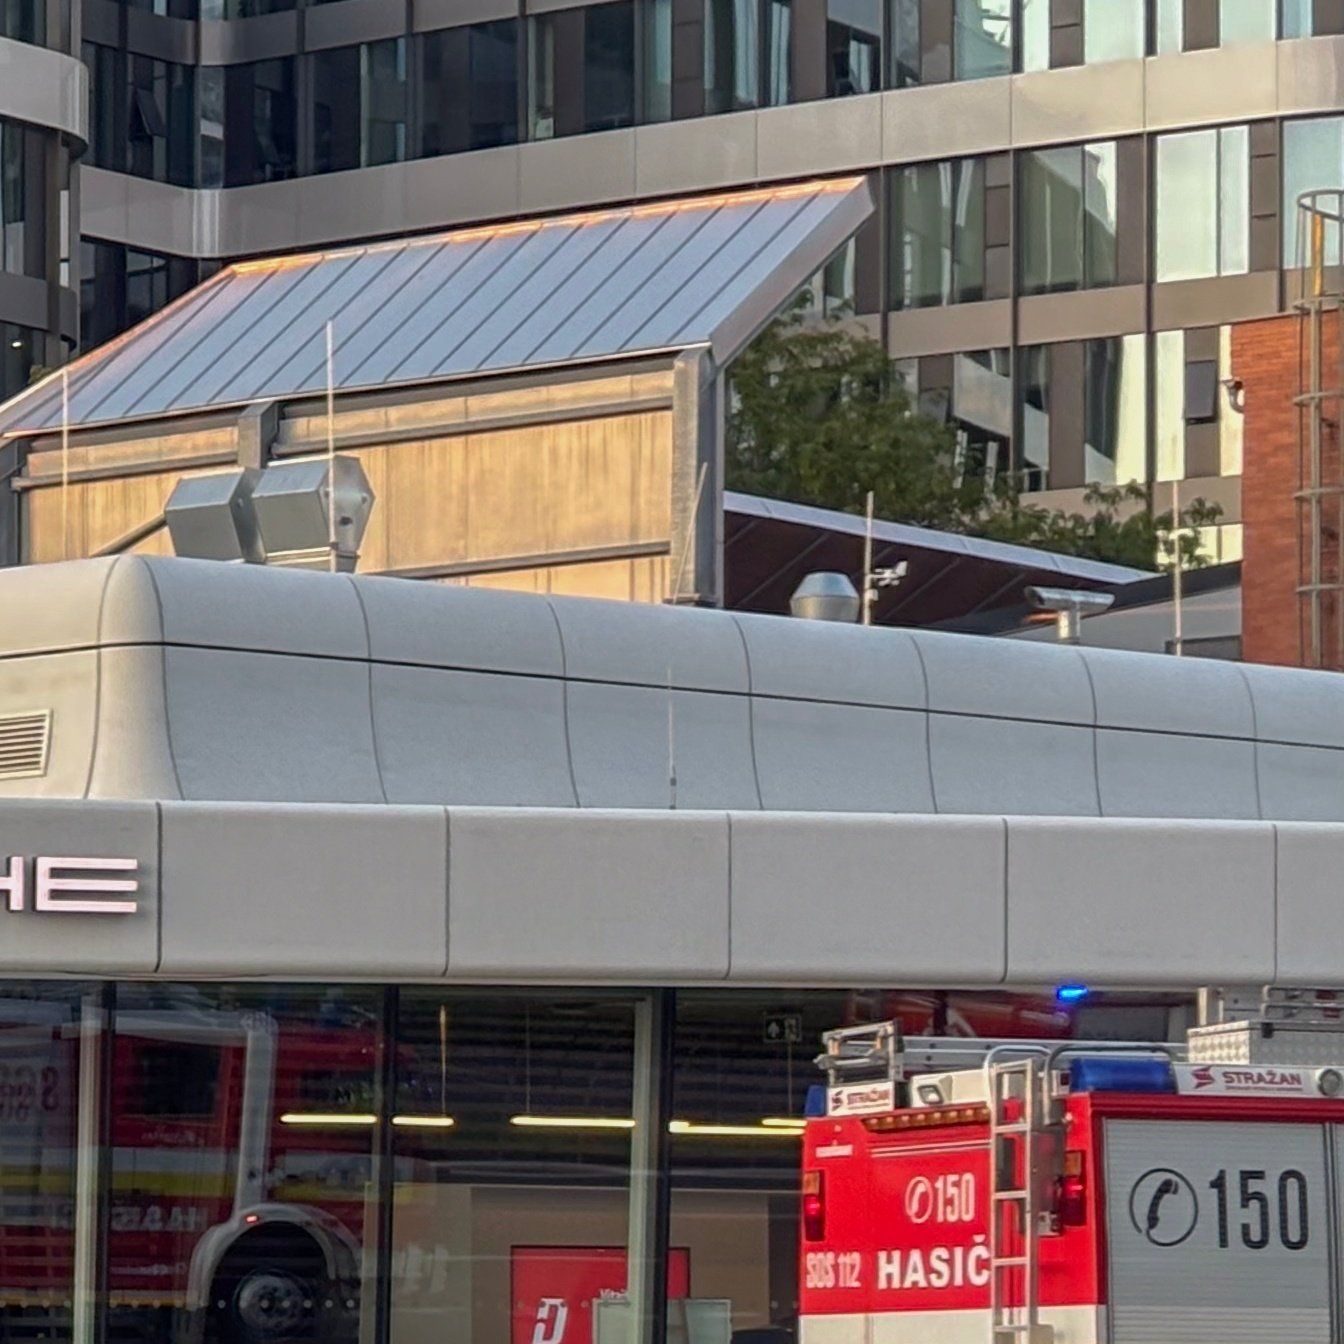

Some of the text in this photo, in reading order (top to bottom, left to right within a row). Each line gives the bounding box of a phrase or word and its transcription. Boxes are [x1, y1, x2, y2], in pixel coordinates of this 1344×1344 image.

[1222, 1069, 1302, 1085] STRAŽAN
[934, 1172, 975, 1223] 150
[1209, 1169, 1309, 1250] 150
[806, 1251, 862, 1289] SOS 112
